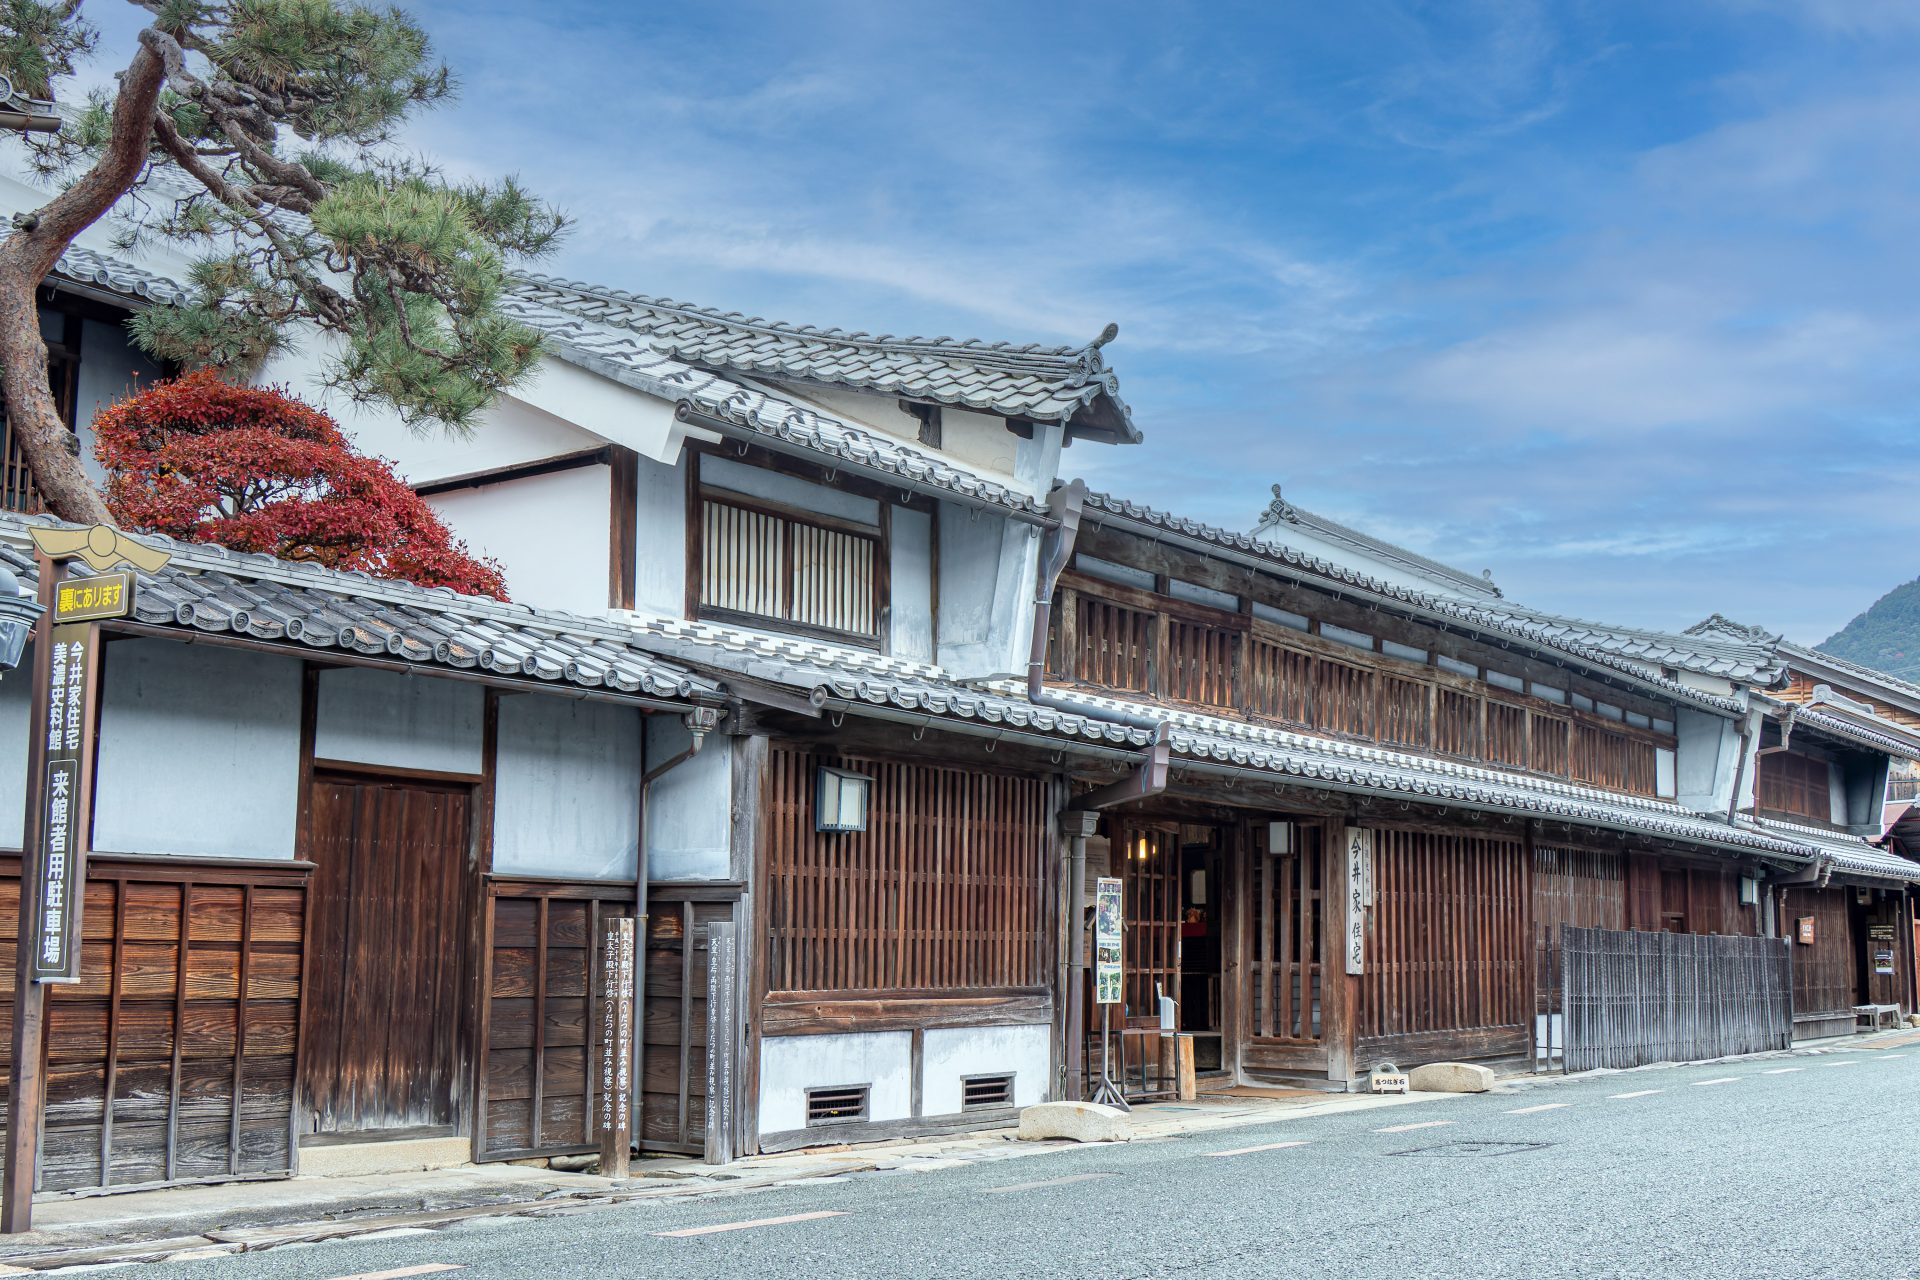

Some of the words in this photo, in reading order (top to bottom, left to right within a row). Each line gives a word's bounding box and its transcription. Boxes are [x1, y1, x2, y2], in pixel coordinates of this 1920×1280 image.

[59, 584, 122, 612] 裏にあります
[48, 642, 68, 750] 美濃史料館
[65, 641, 84, 750] 今井家住宅
[43, 769, 69, 964] 来館者用駐車場
